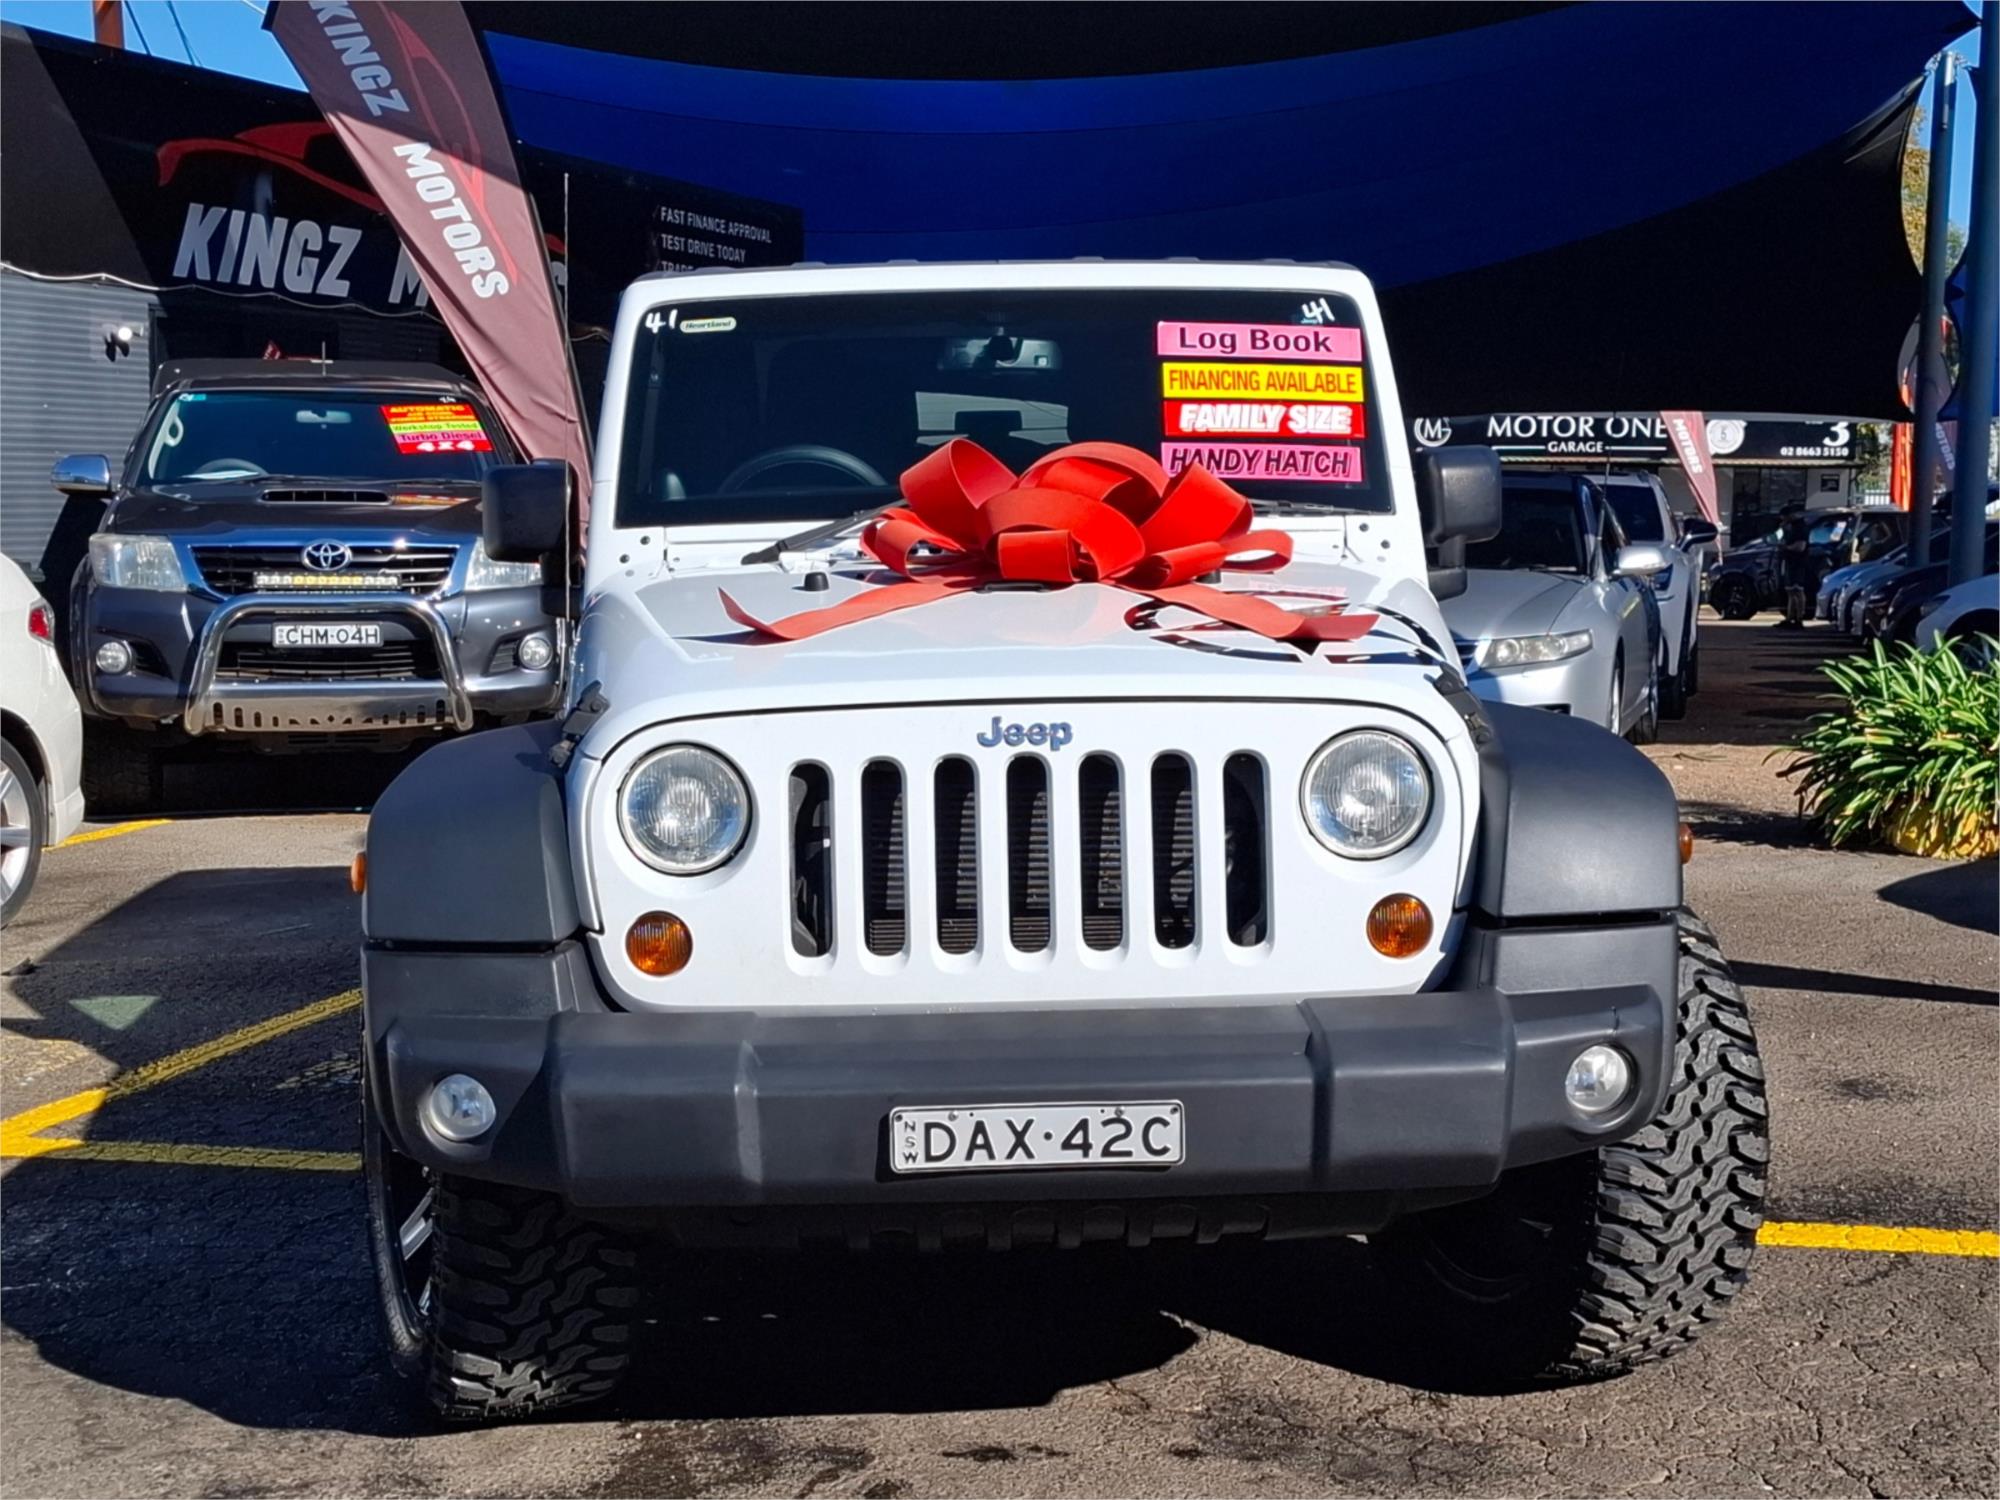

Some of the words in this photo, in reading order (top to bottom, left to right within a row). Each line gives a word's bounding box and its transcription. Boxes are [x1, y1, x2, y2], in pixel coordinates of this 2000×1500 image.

[309, 0, 410, 117] KINGZ
[393, 142, 510, 299] MOTORS
[660, 206, 686, 226] FAST
[687, 212, 727, 234] FINANCE
[728, 221, 772, 244] APPROVAL
[172, 202, 363, 298] KINGZ
[660, 233, 686, 252] TEST
[687, 238, 716, 258] DRIVE
[716, 244, 747, 263] TODAY
[1302, 297, 1335, 324] 41
[1179, 326, 1238, 354] Log
[1249, 328, 1333, 353] Book
[1168, 369, 1261, 392] FINANCING
[1265, 371, 1357, 395] AVAILABLE
[1178, 403, 1286, 433] FAMILY
[1287, 404, 1353, 435] SIZE
[1487, 415, 1595, 438] MOTOR
[1604, 416, 1667, 438] ONE
[401, 433, 438, 441] Turbo
[441, 431, 482, 440] Diesel
[1547, 441, 1604, 453] GARAGE
[1264, 450, 1352, 477] HATCH
[976, 715, 1073, 752] Jeep
